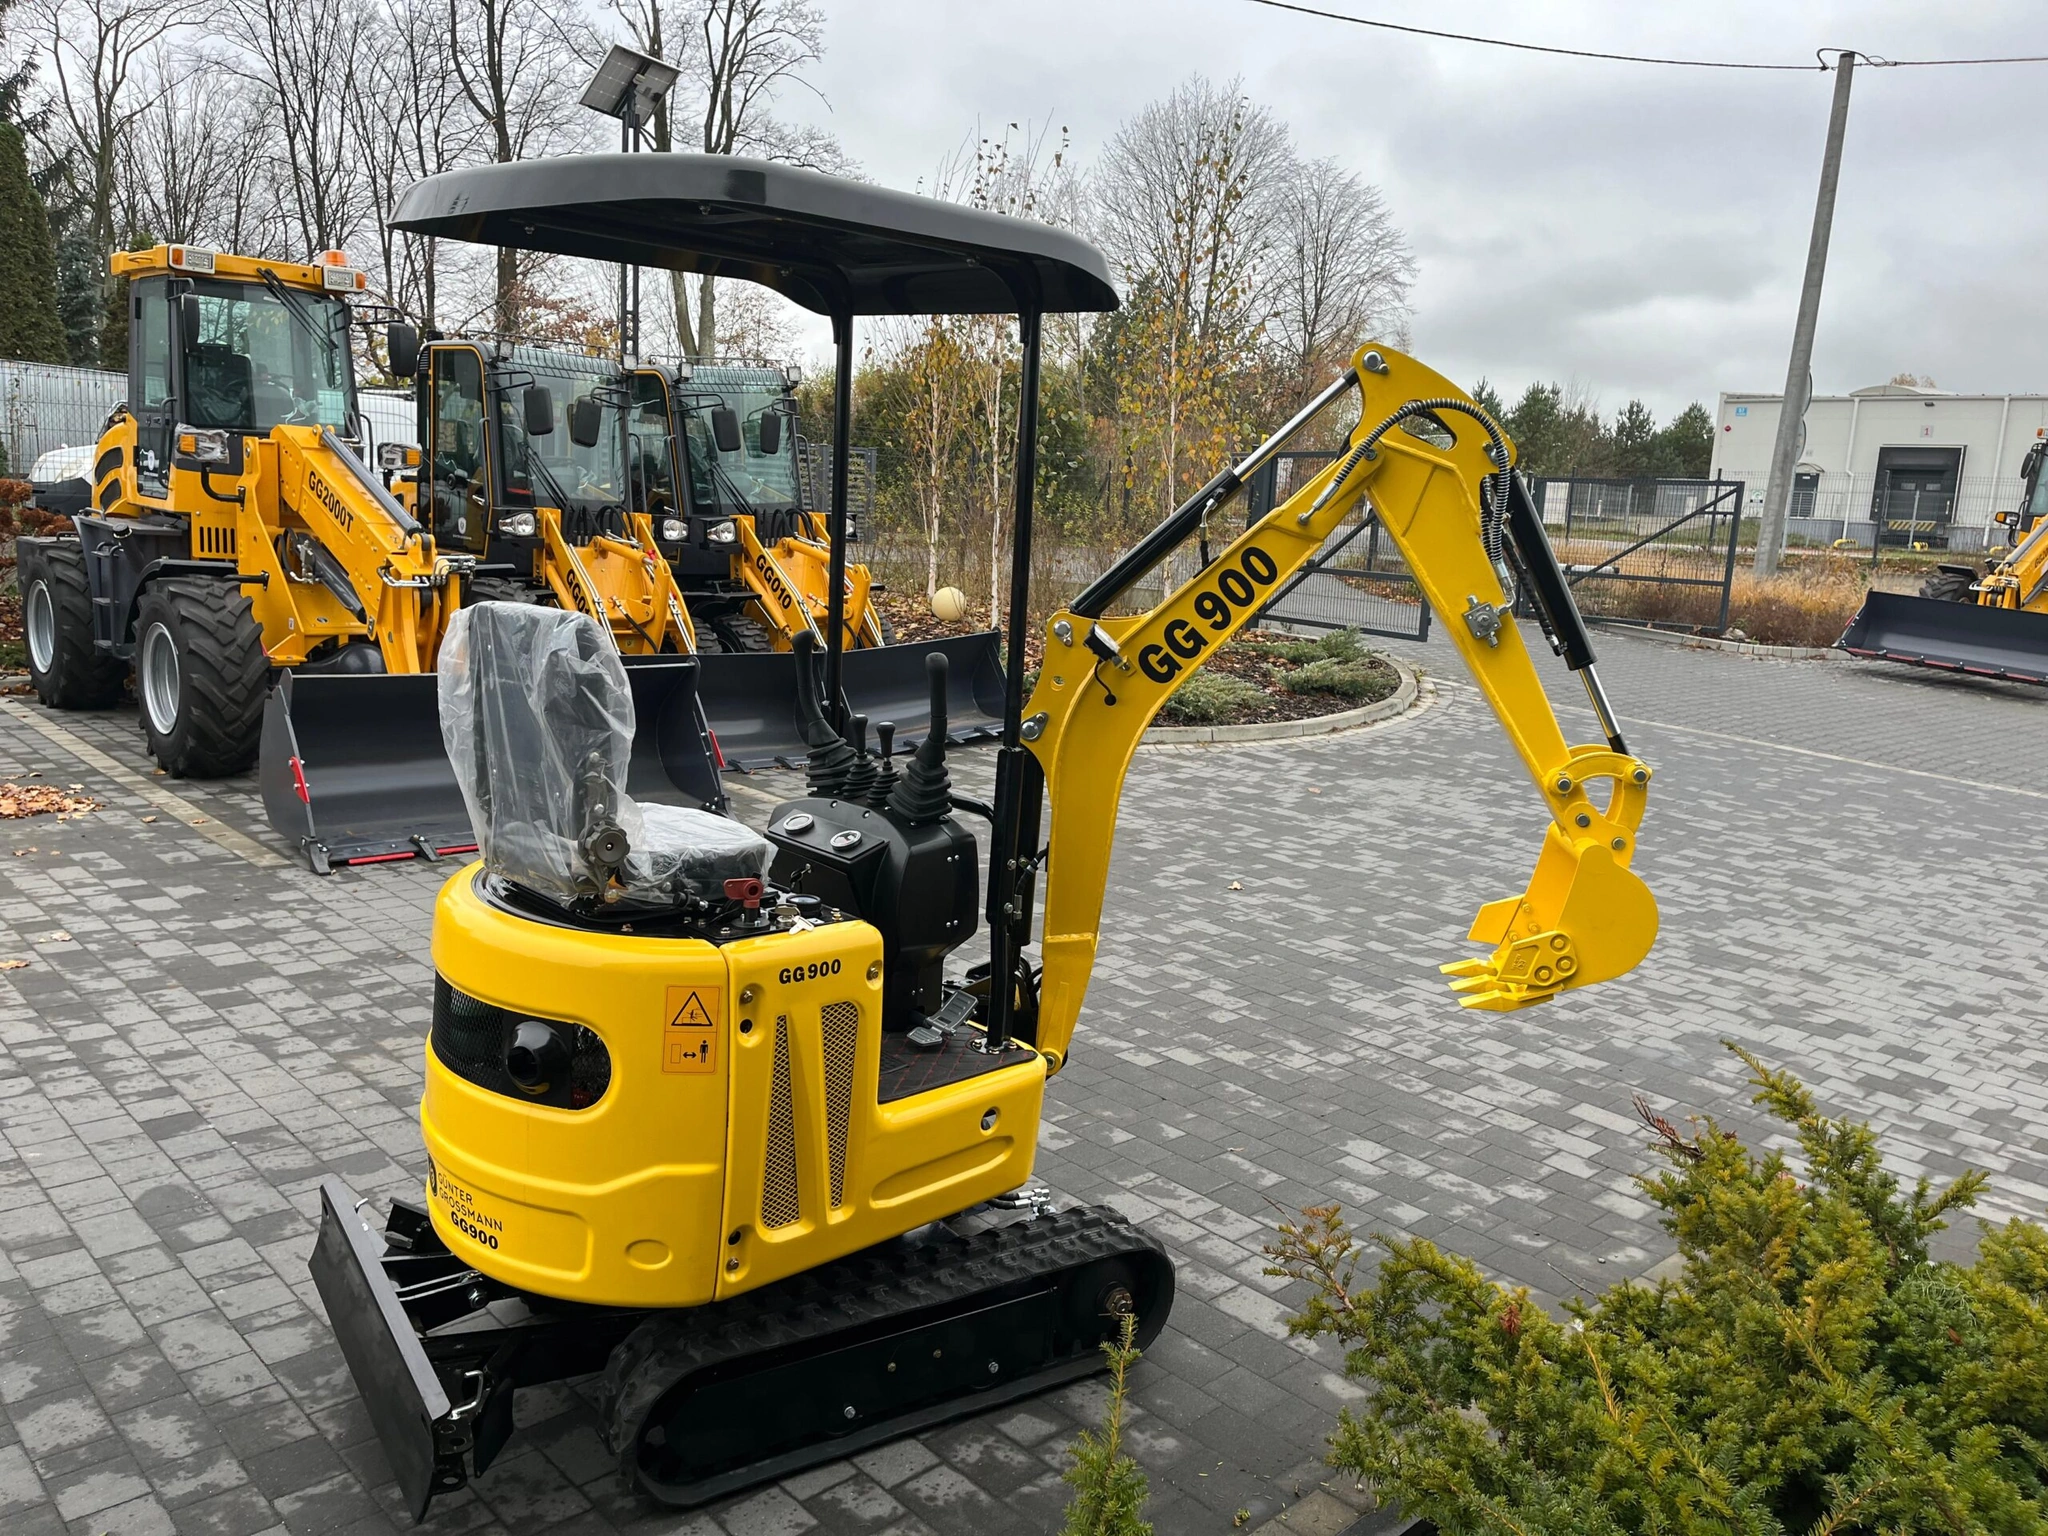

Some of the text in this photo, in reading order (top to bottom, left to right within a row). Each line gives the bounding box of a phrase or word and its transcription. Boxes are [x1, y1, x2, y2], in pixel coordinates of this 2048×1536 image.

[309, 470, 354, 533] GG2000T
[566, 568, 590, 613] GG0
[756, 554, 792, 609] GG010
[438, 1172, 473, 1206] GÜNTER
[438, 1187, 503, 1232] GROSSMANN
[450, 1210, 499, 1250] GG900
